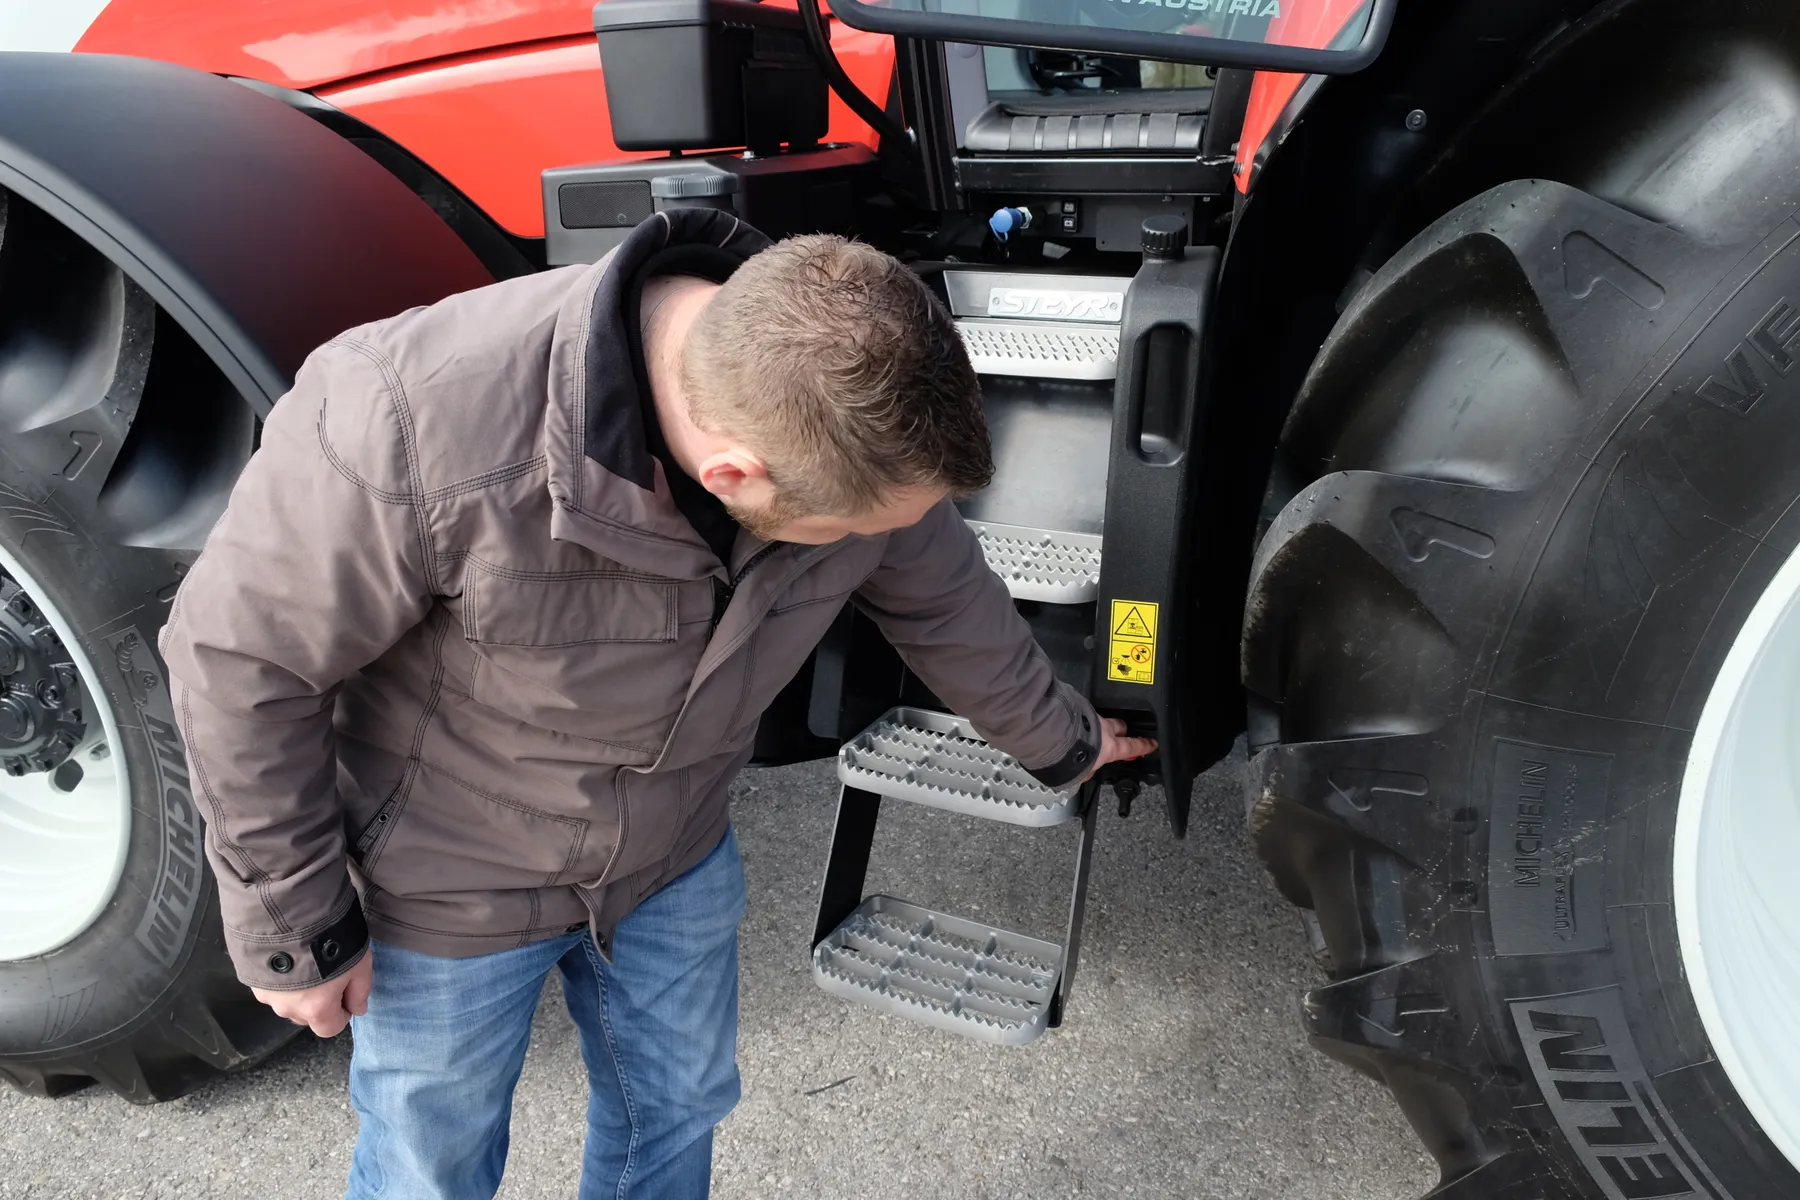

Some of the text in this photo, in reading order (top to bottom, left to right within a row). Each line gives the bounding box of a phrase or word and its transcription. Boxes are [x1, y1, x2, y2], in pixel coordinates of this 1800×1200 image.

[999, 290, 1110, 318] STEYR
[144, 713, 198, 960] MICHELIN
[1514, 759, 1548, 887] MICHELIN
